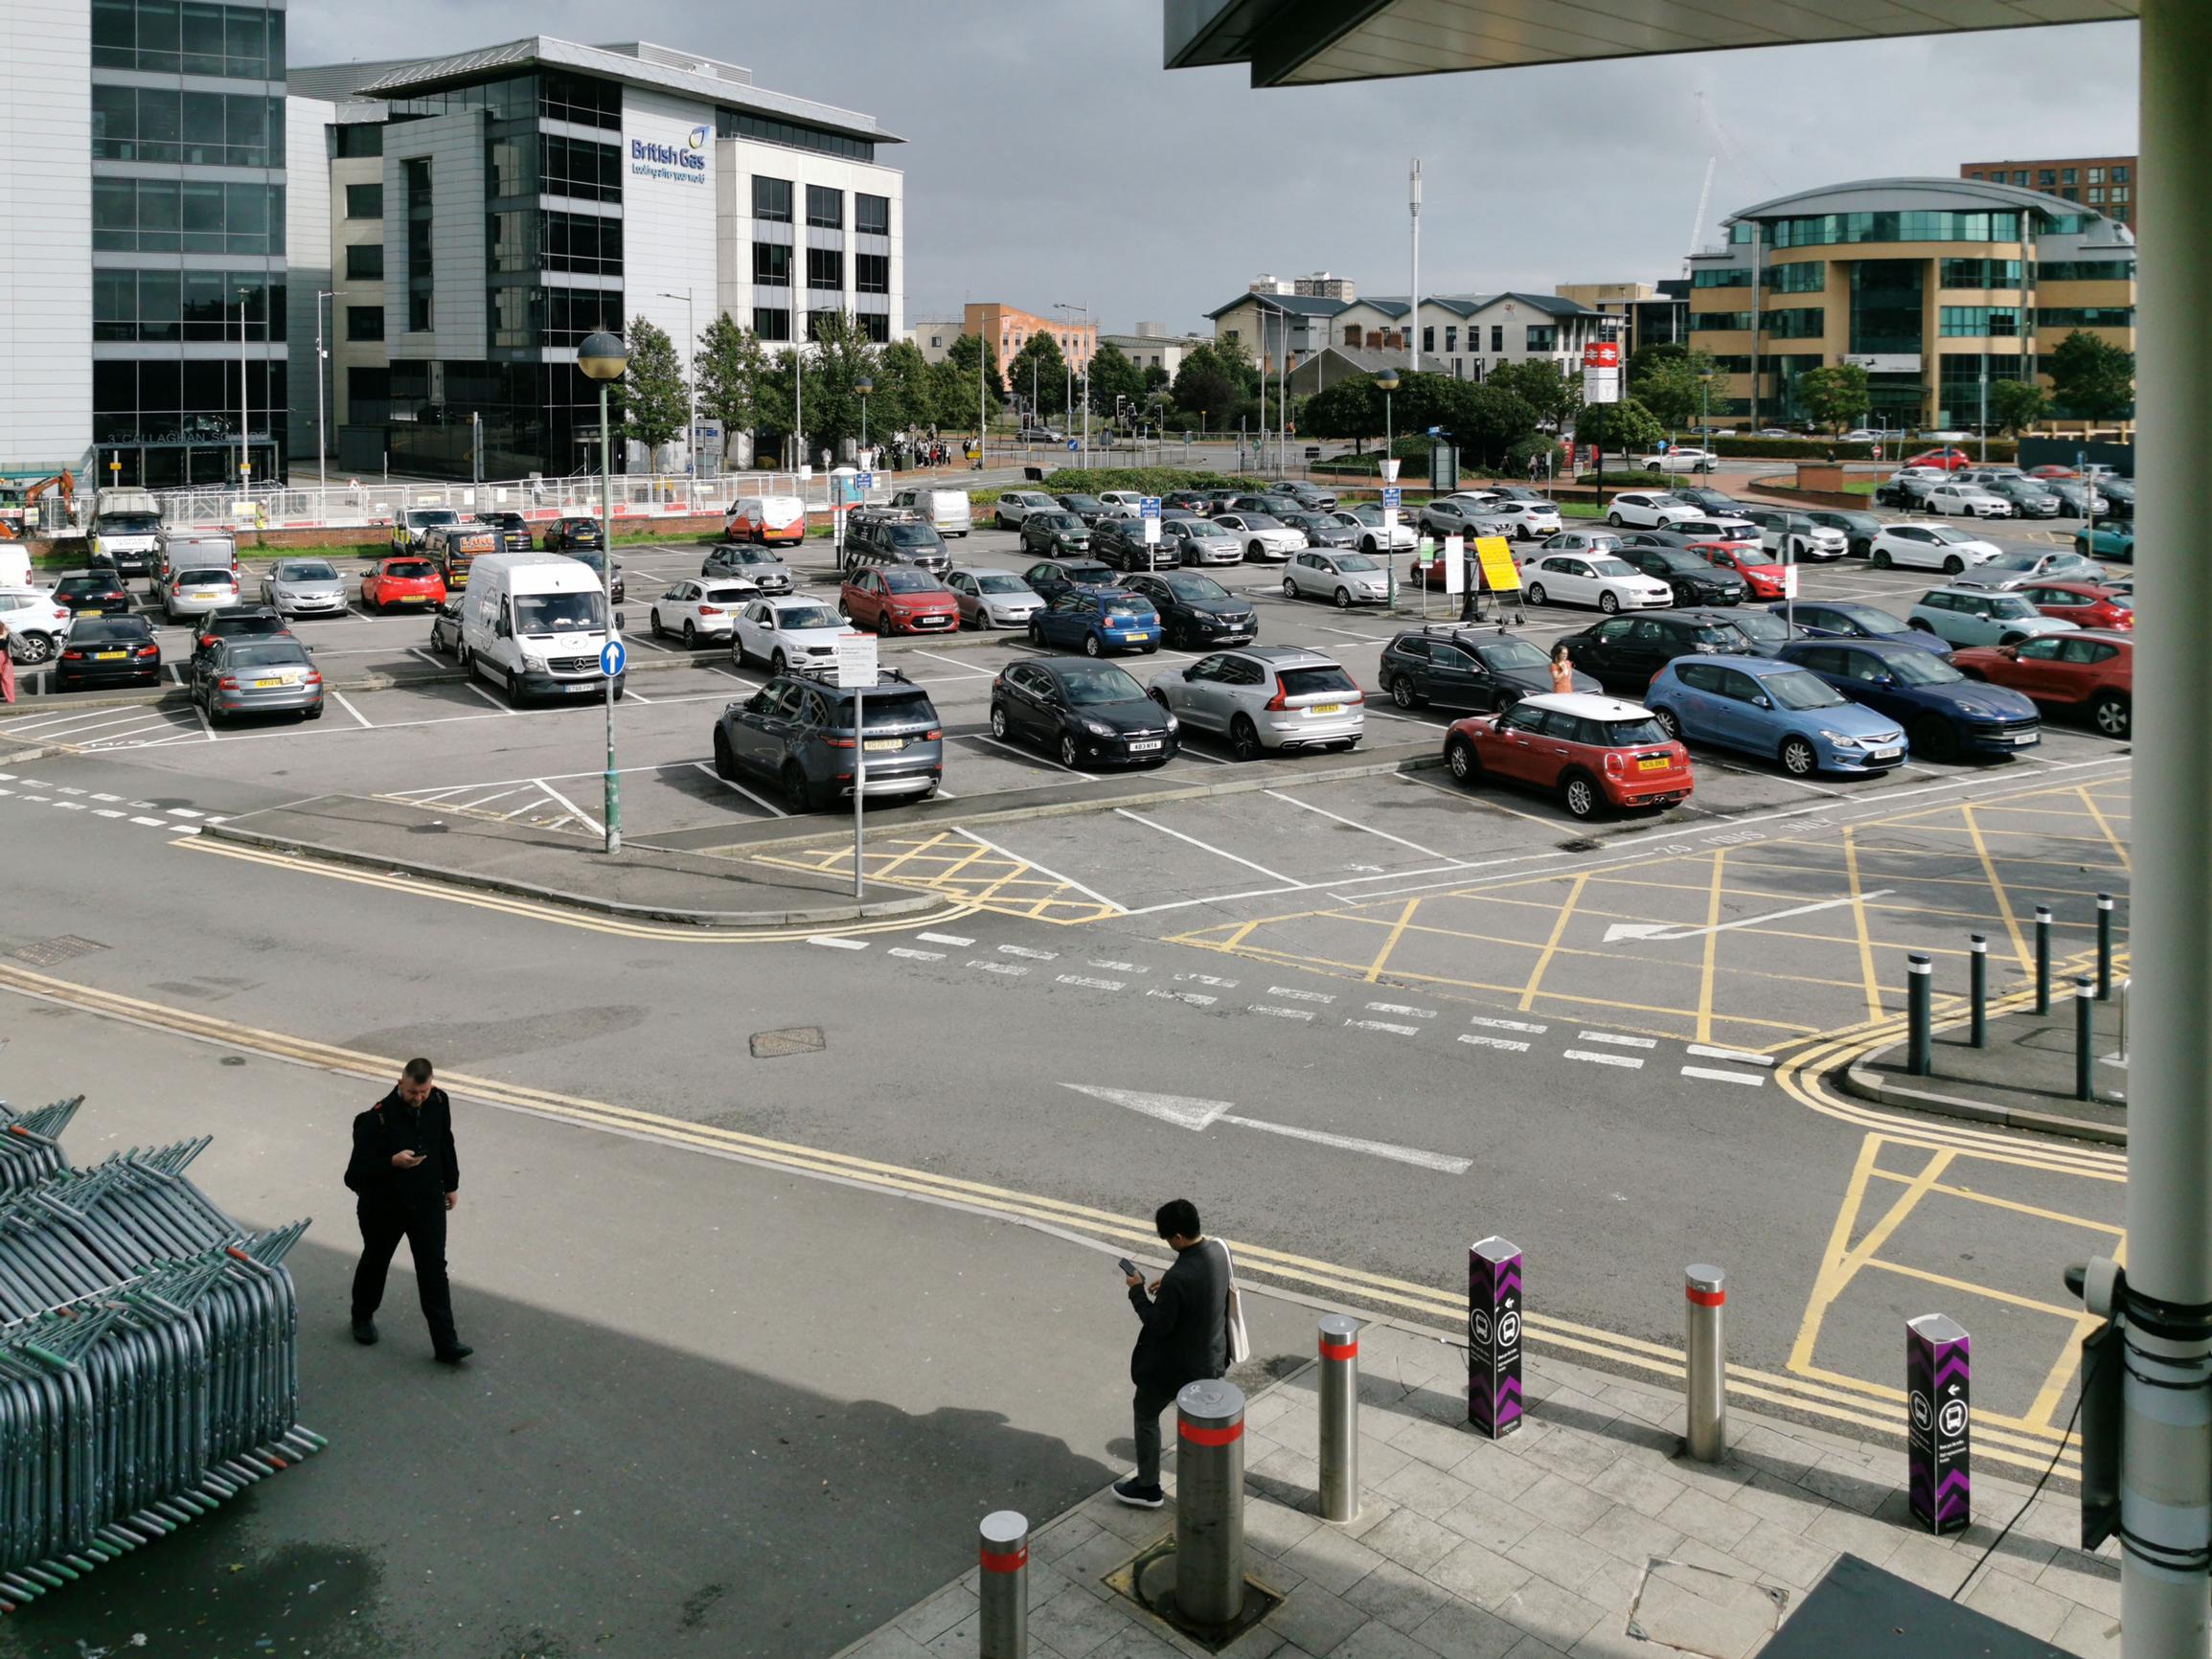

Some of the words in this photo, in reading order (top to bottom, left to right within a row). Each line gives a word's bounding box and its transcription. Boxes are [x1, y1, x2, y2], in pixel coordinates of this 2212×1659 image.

[632, 139, 677, 166] British
[679, 148, 705, 170] Gas
[632, 163, 657, 179] Looking
[107, 433, 116, 444] 3
[122, 430, 206, 444] CALLAGHAN
[212, 430, 270, 443] SQURE
[1699, 830, 1767, 846] MINS
